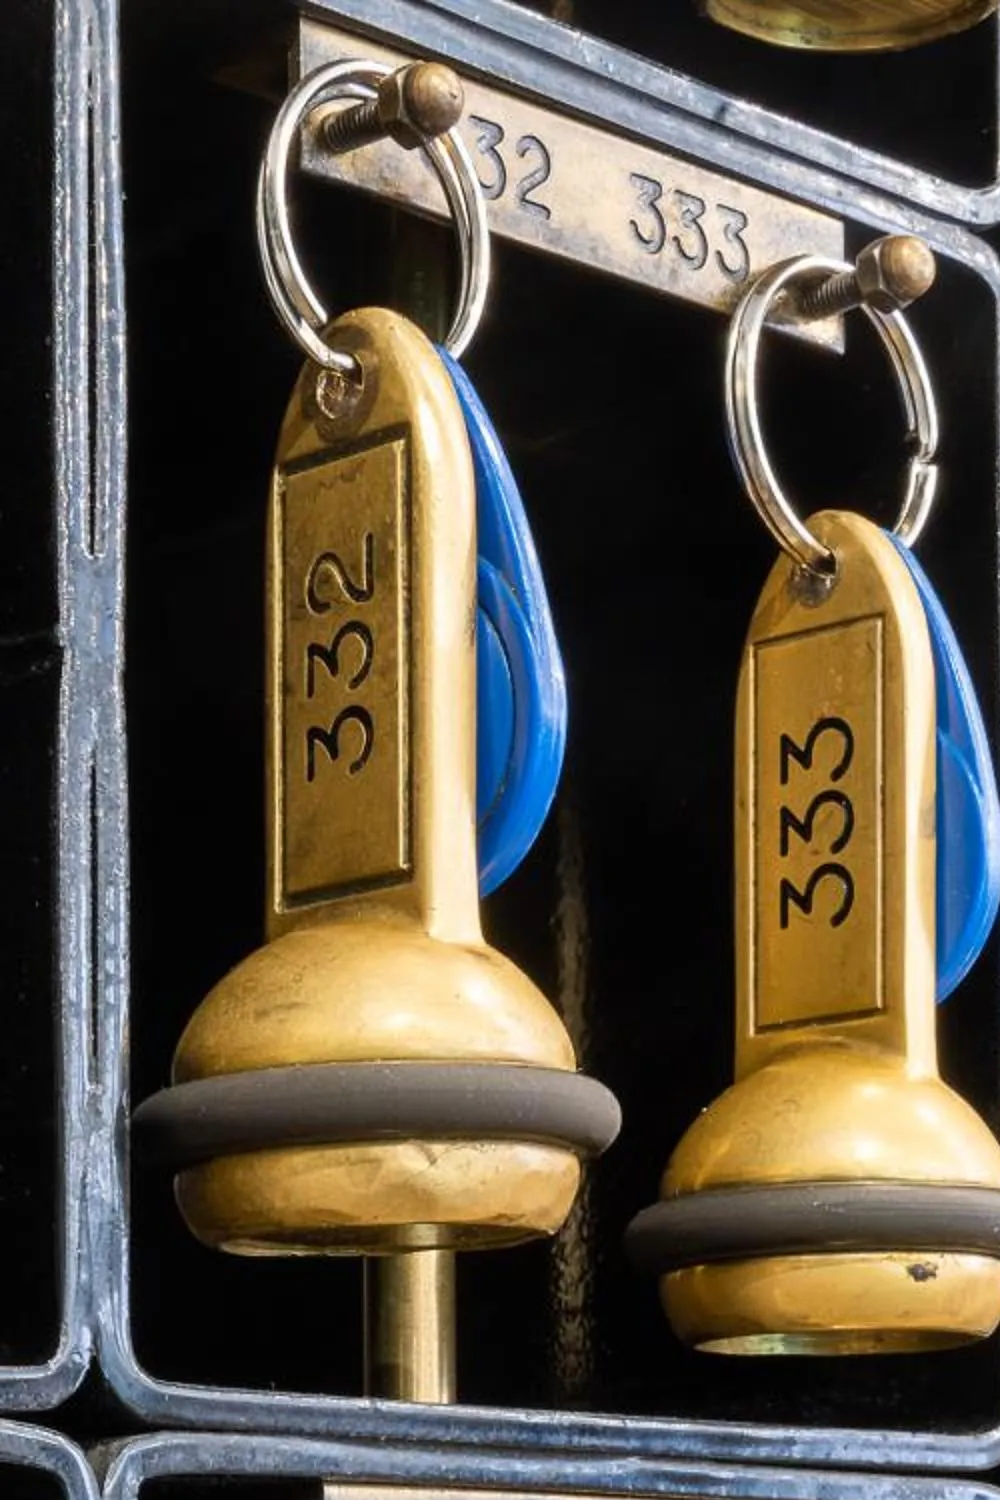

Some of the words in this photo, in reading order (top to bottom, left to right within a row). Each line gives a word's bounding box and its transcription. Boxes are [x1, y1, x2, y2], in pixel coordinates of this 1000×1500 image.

[469, 114, 551, 220] 32
[629, 172, 751, 280] 333
[306, 531, 375, 783] 332
[780, 715, 855, 930] 333
